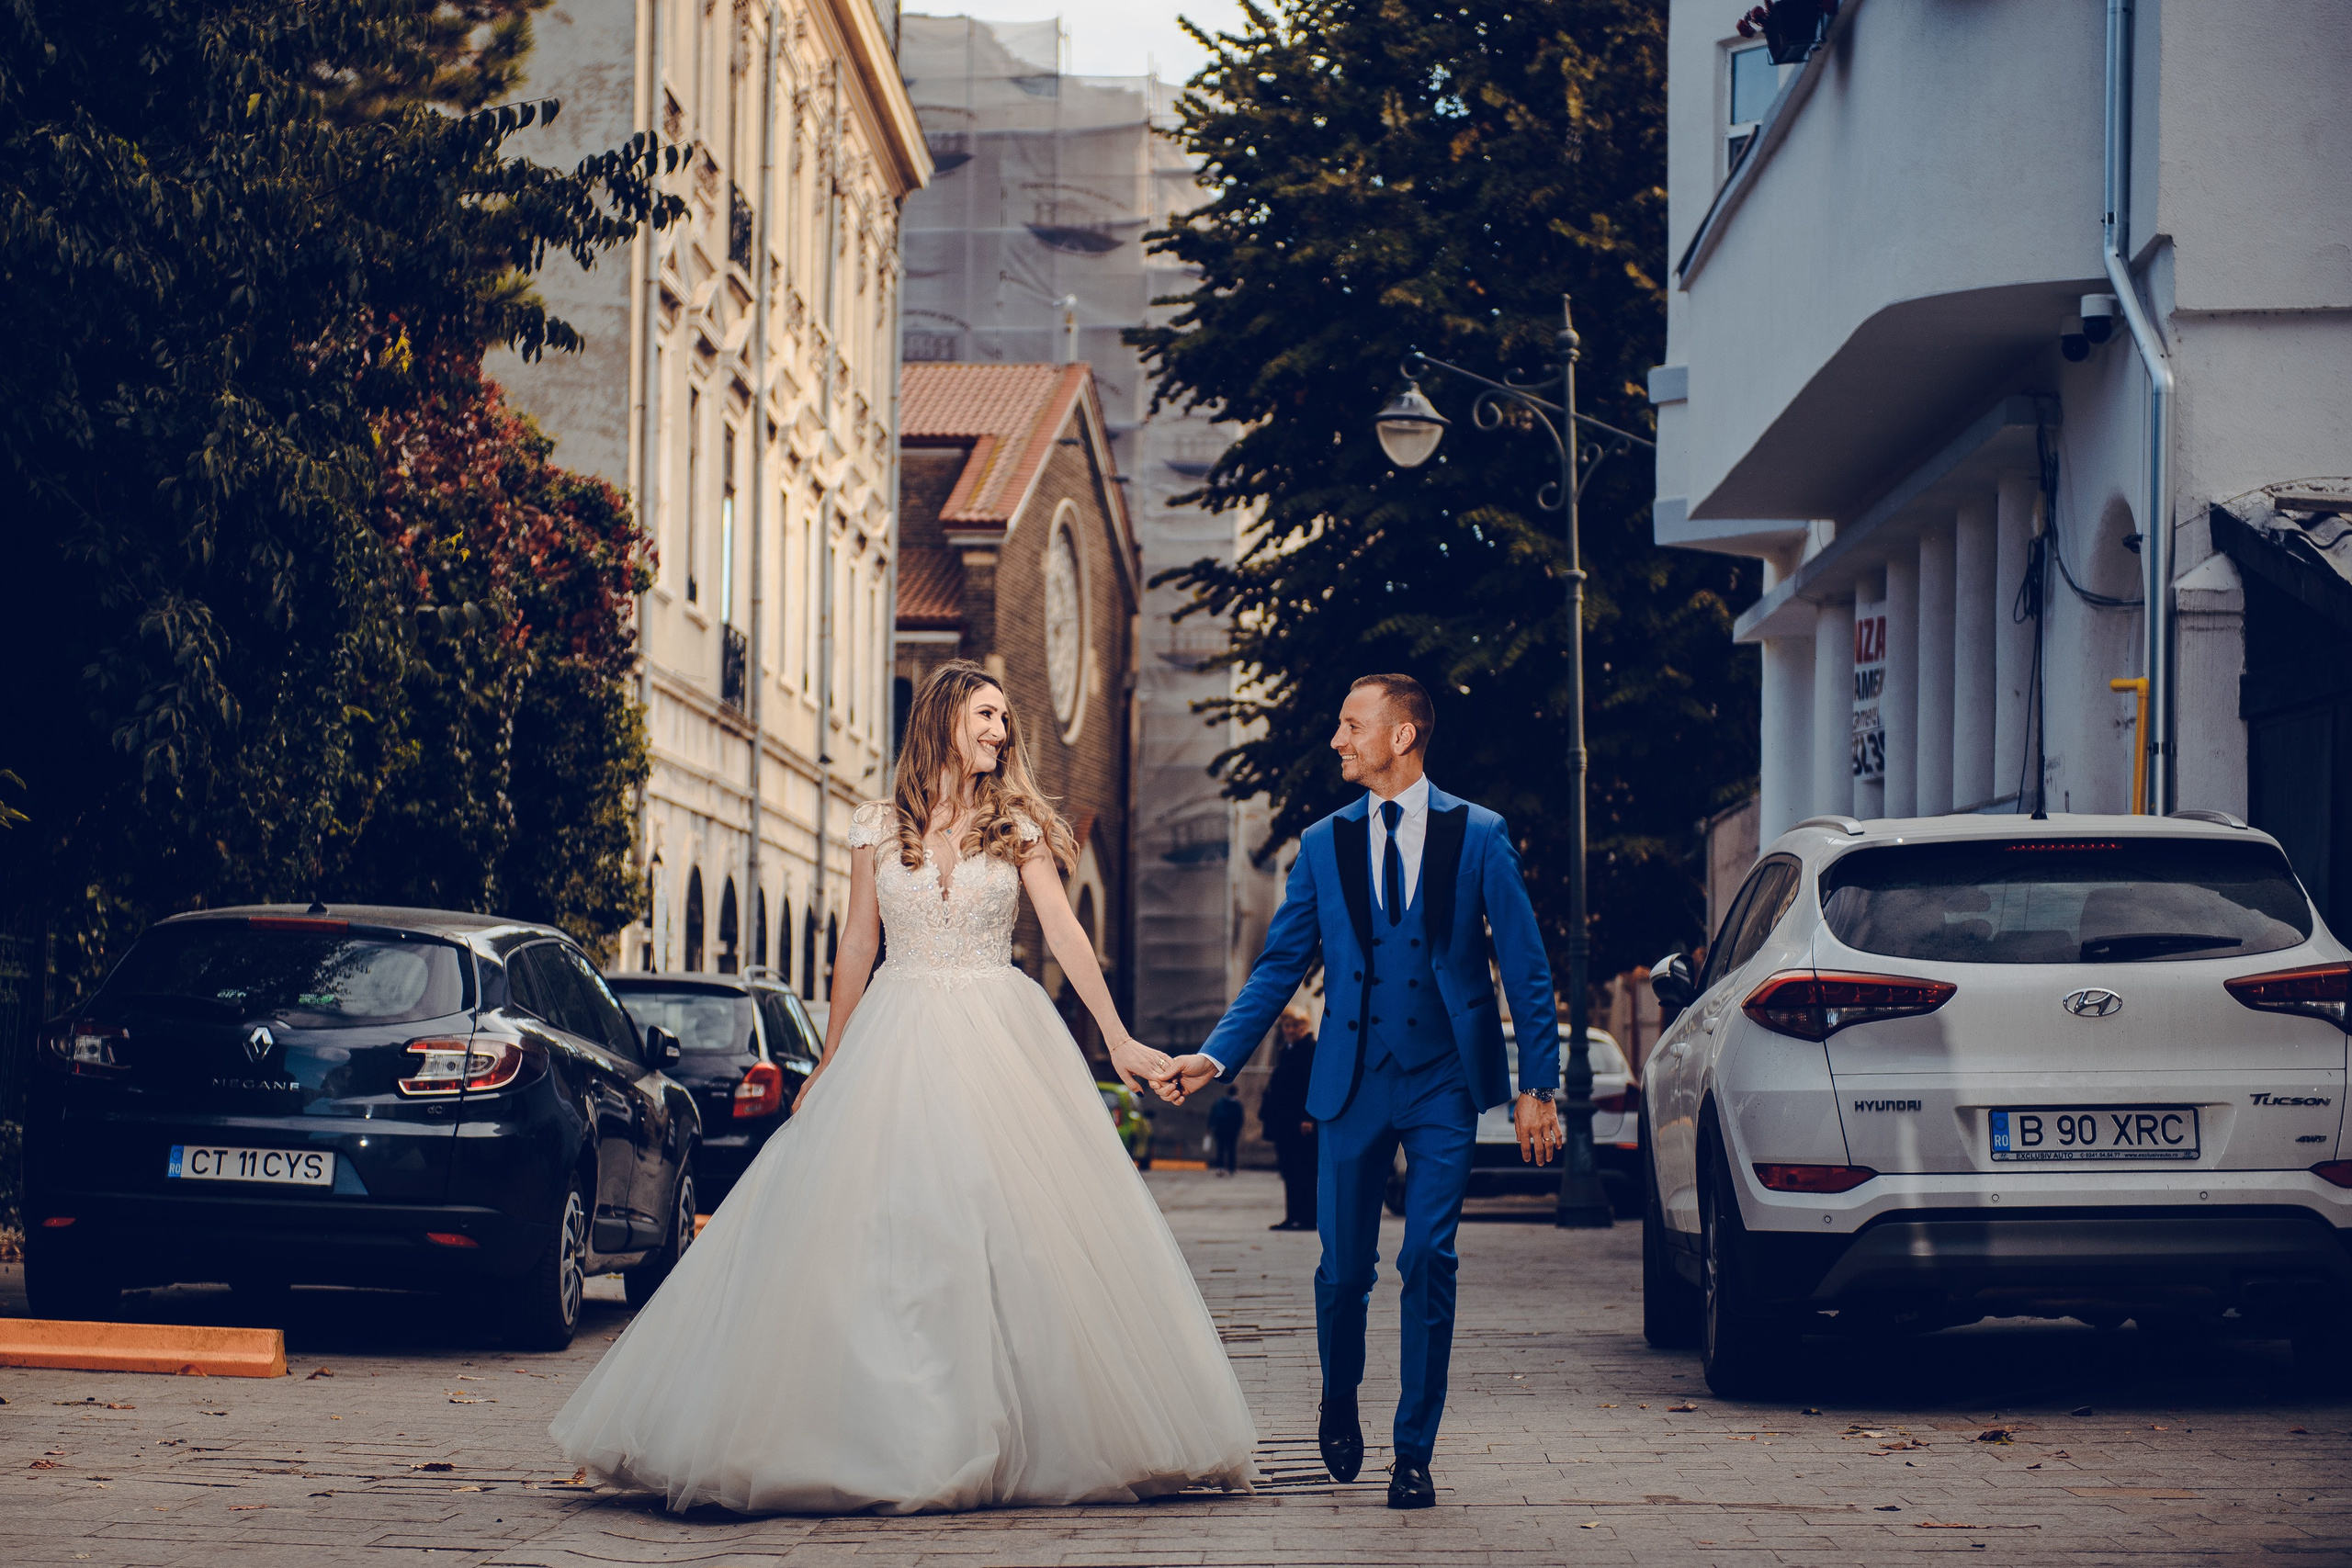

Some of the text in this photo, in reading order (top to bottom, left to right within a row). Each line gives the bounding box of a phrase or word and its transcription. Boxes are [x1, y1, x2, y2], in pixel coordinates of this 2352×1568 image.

[1854, 1100, 1922, 1112] HYUNDAI
[2019, 1114, 2185, 1146] B 90 XRC
[1995, 1134, 2009, 1147] RO
[2016, 1152, 2052, 1160] EXCLUSIV
[191, 1149, 229, 1176] CT
[169, 1163, 181, 1175] RO
